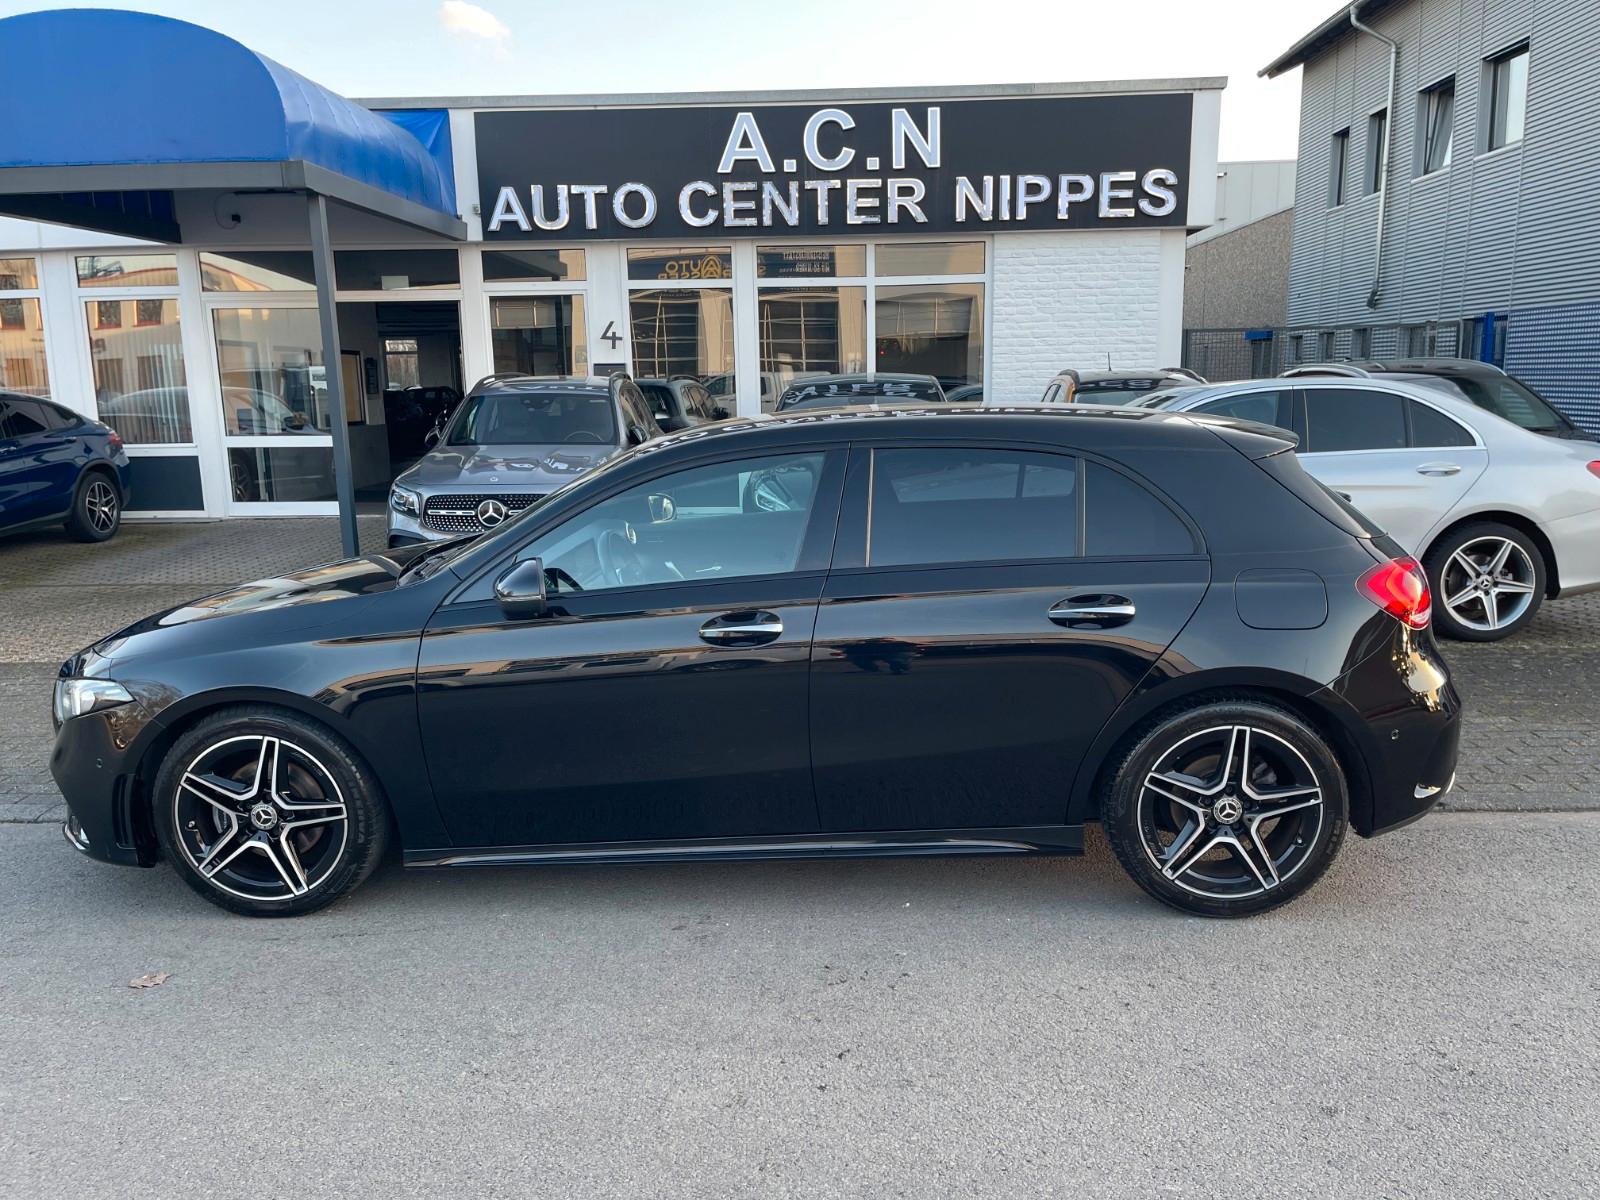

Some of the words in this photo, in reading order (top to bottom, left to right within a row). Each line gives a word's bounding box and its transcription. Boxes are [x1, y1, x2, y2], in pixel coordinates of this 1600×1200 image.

[717, 107, 941, 173] A.C.N
[487, 182, 658, 232] AUTO
[678, 178, 929, 229] CENTER
[955, 169, 1178, 223] NIPPES
[600, 321, 623, 350] 4
